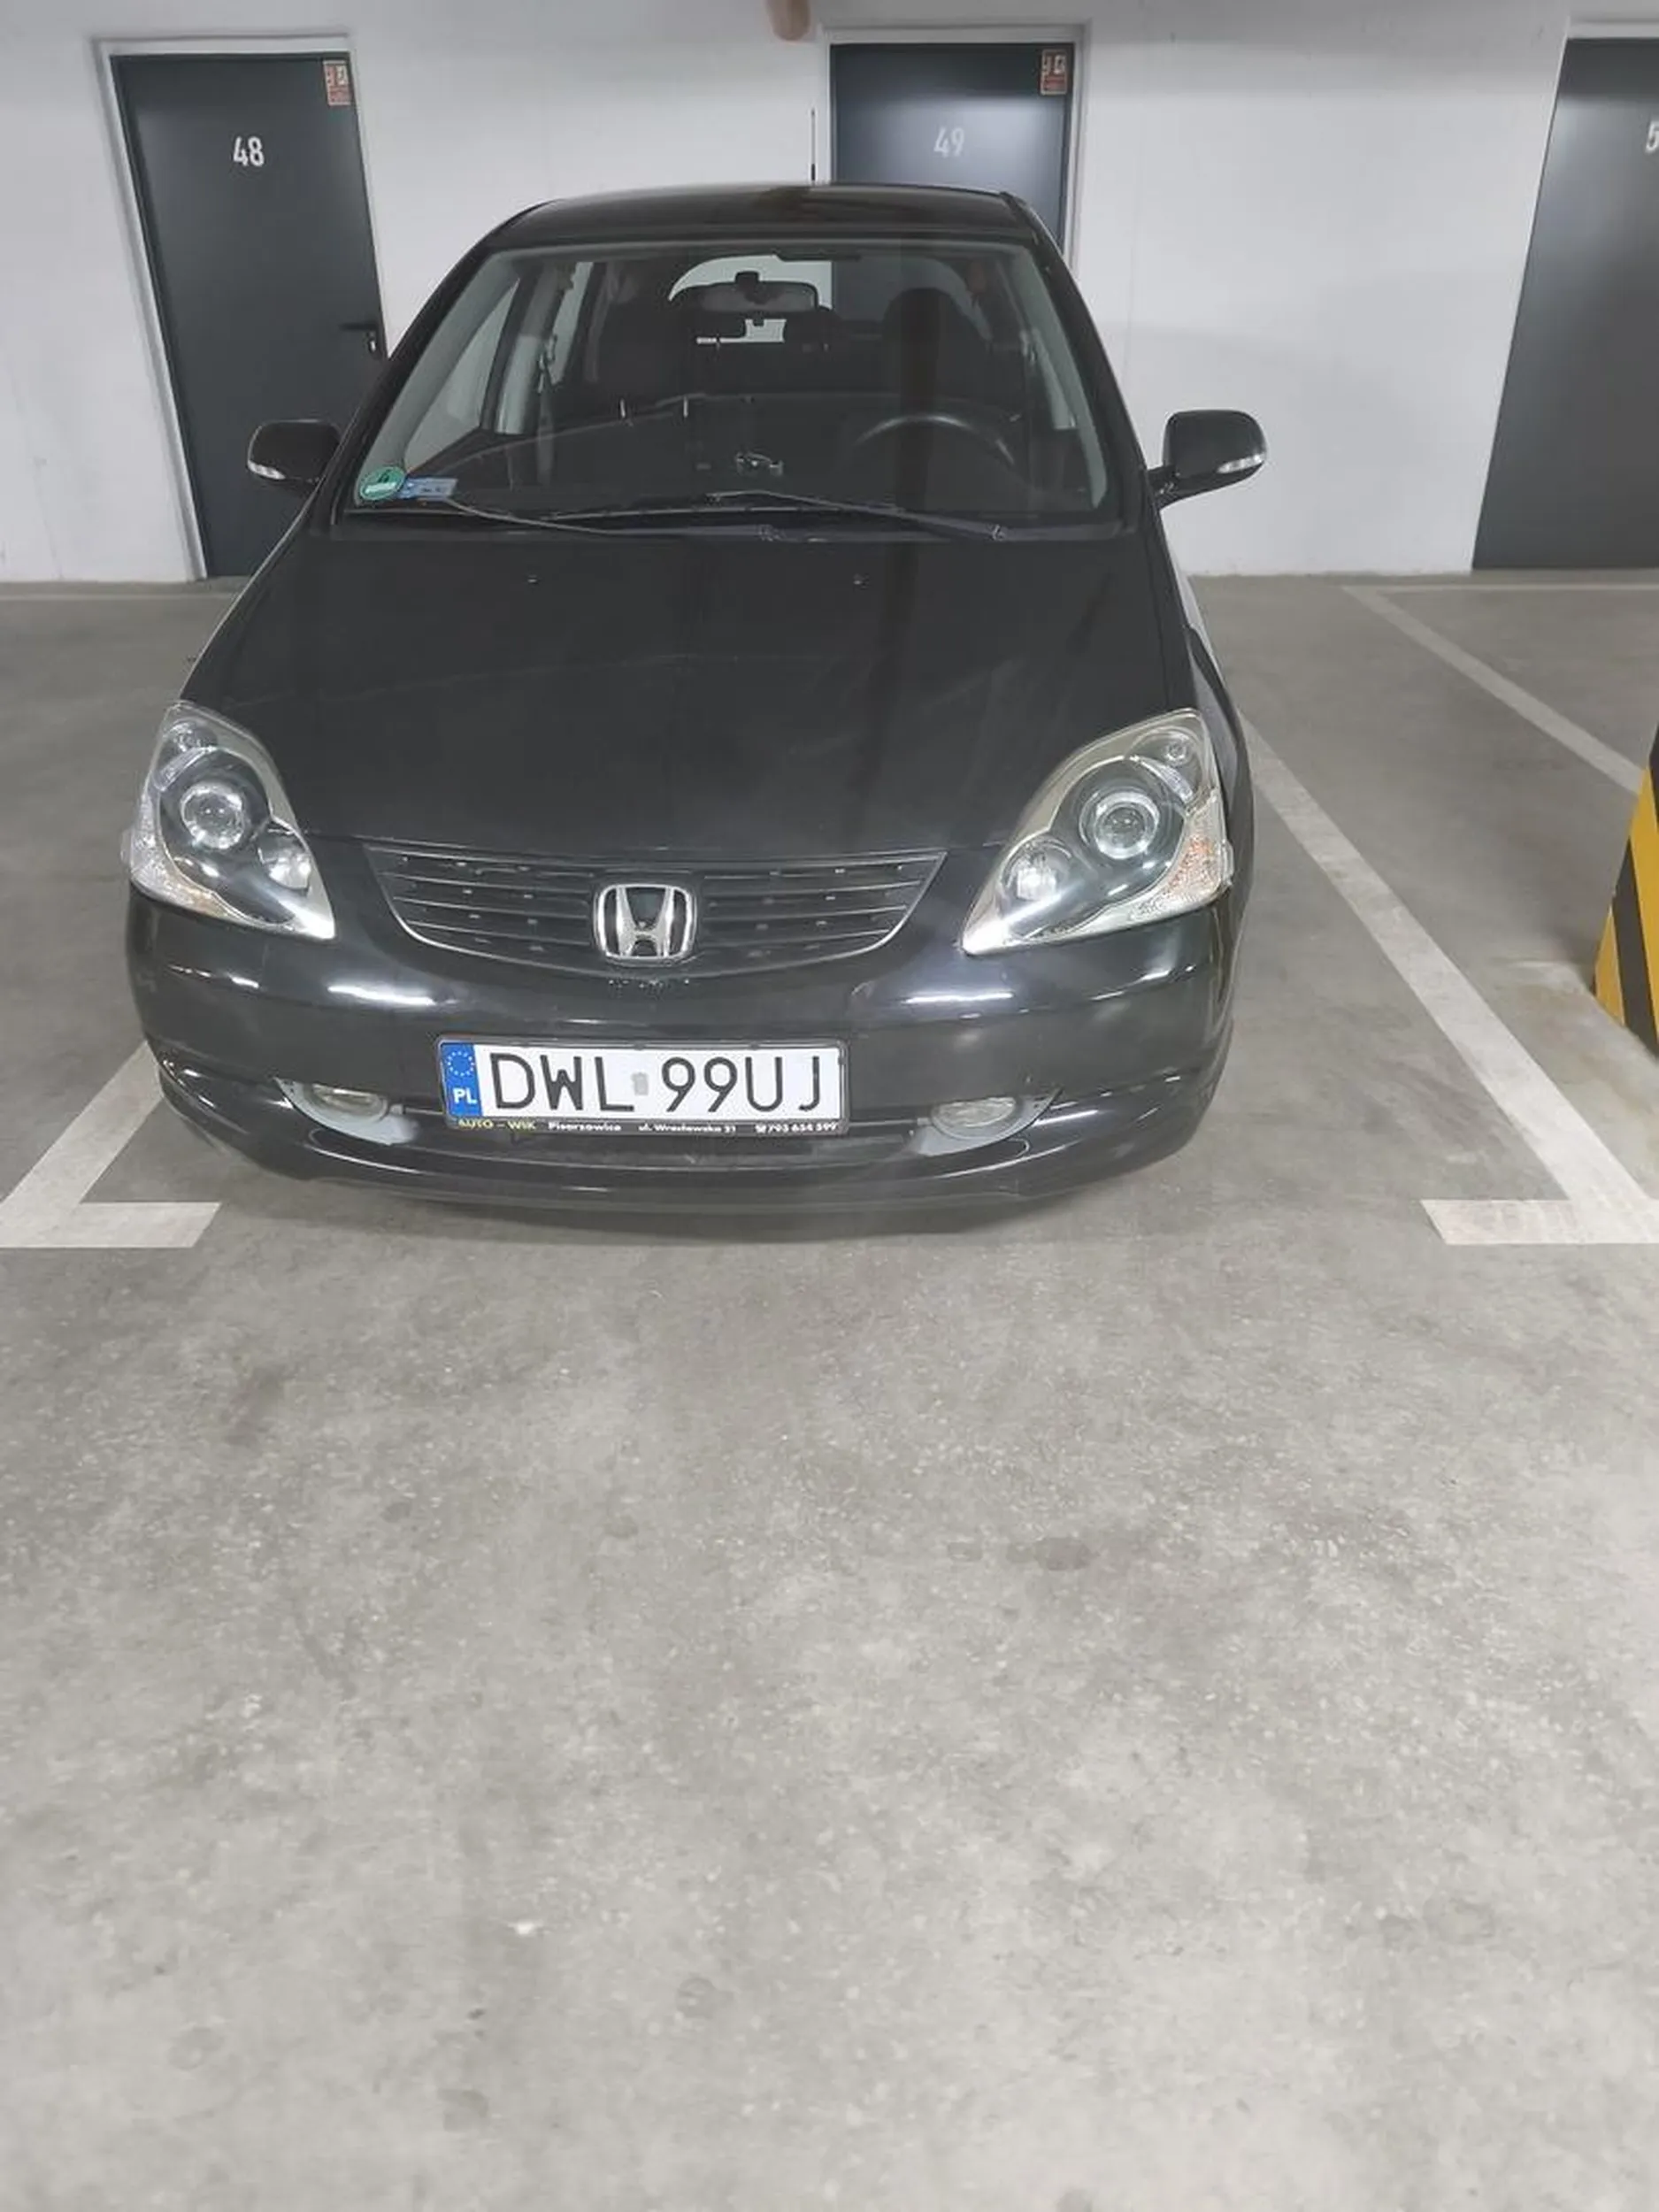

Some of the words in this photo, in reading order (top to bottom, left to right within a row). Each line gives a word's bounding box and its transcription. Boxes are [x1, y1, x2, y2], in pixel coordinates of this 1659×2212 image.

[233, 135, 265, 167] 48
[933, 127, 965, 158] 49
[453, 1087, 478, 1105] PL
[488, 1052, 635, 1112] DWL
[661, 1056, 820, 1113] 99UJ
[457, 1118, 495, 1130] AUTO
